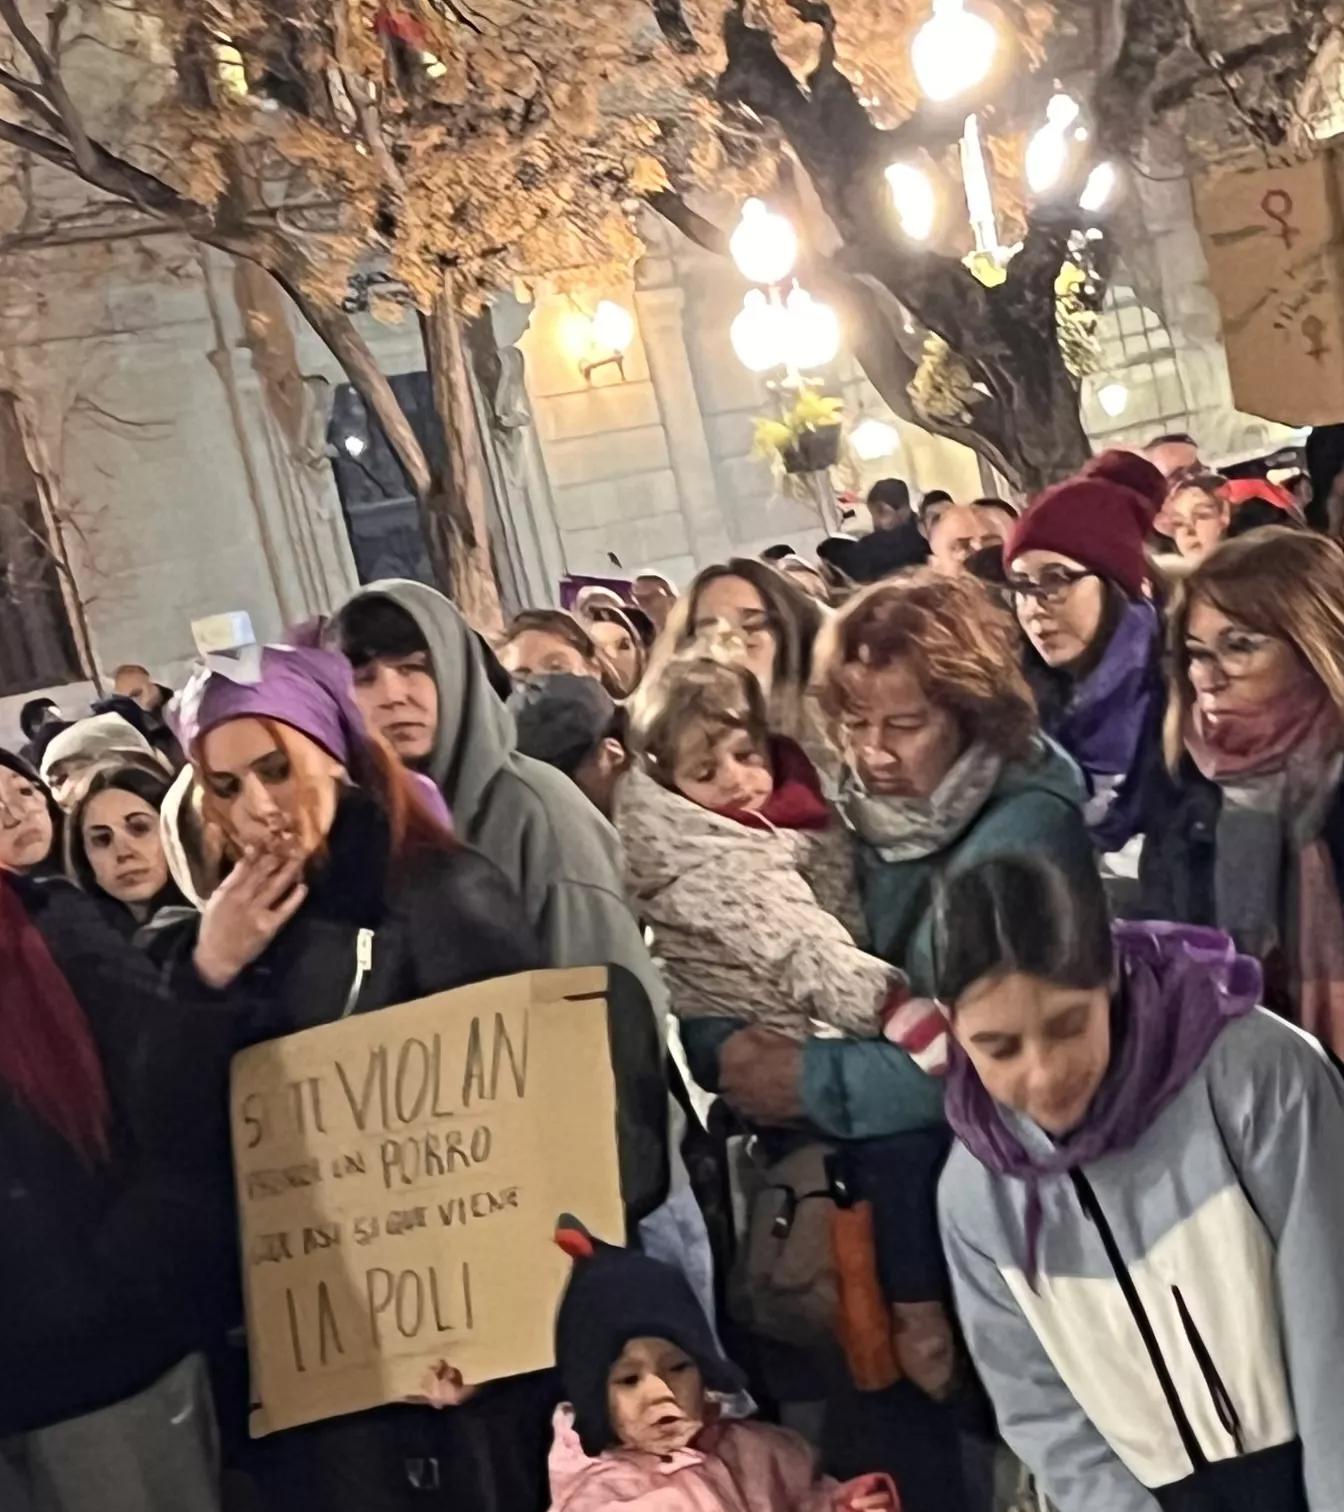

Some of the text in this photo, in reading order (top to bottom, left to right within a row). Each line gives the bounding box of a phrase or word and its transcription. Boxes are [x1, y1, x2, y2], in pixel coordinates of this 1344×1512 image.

[335, 1008, 530, 1132] VIOLAN
[379, 1125, 493, 1190] PORRO
[365, 1261, 475, 1351] POLI
